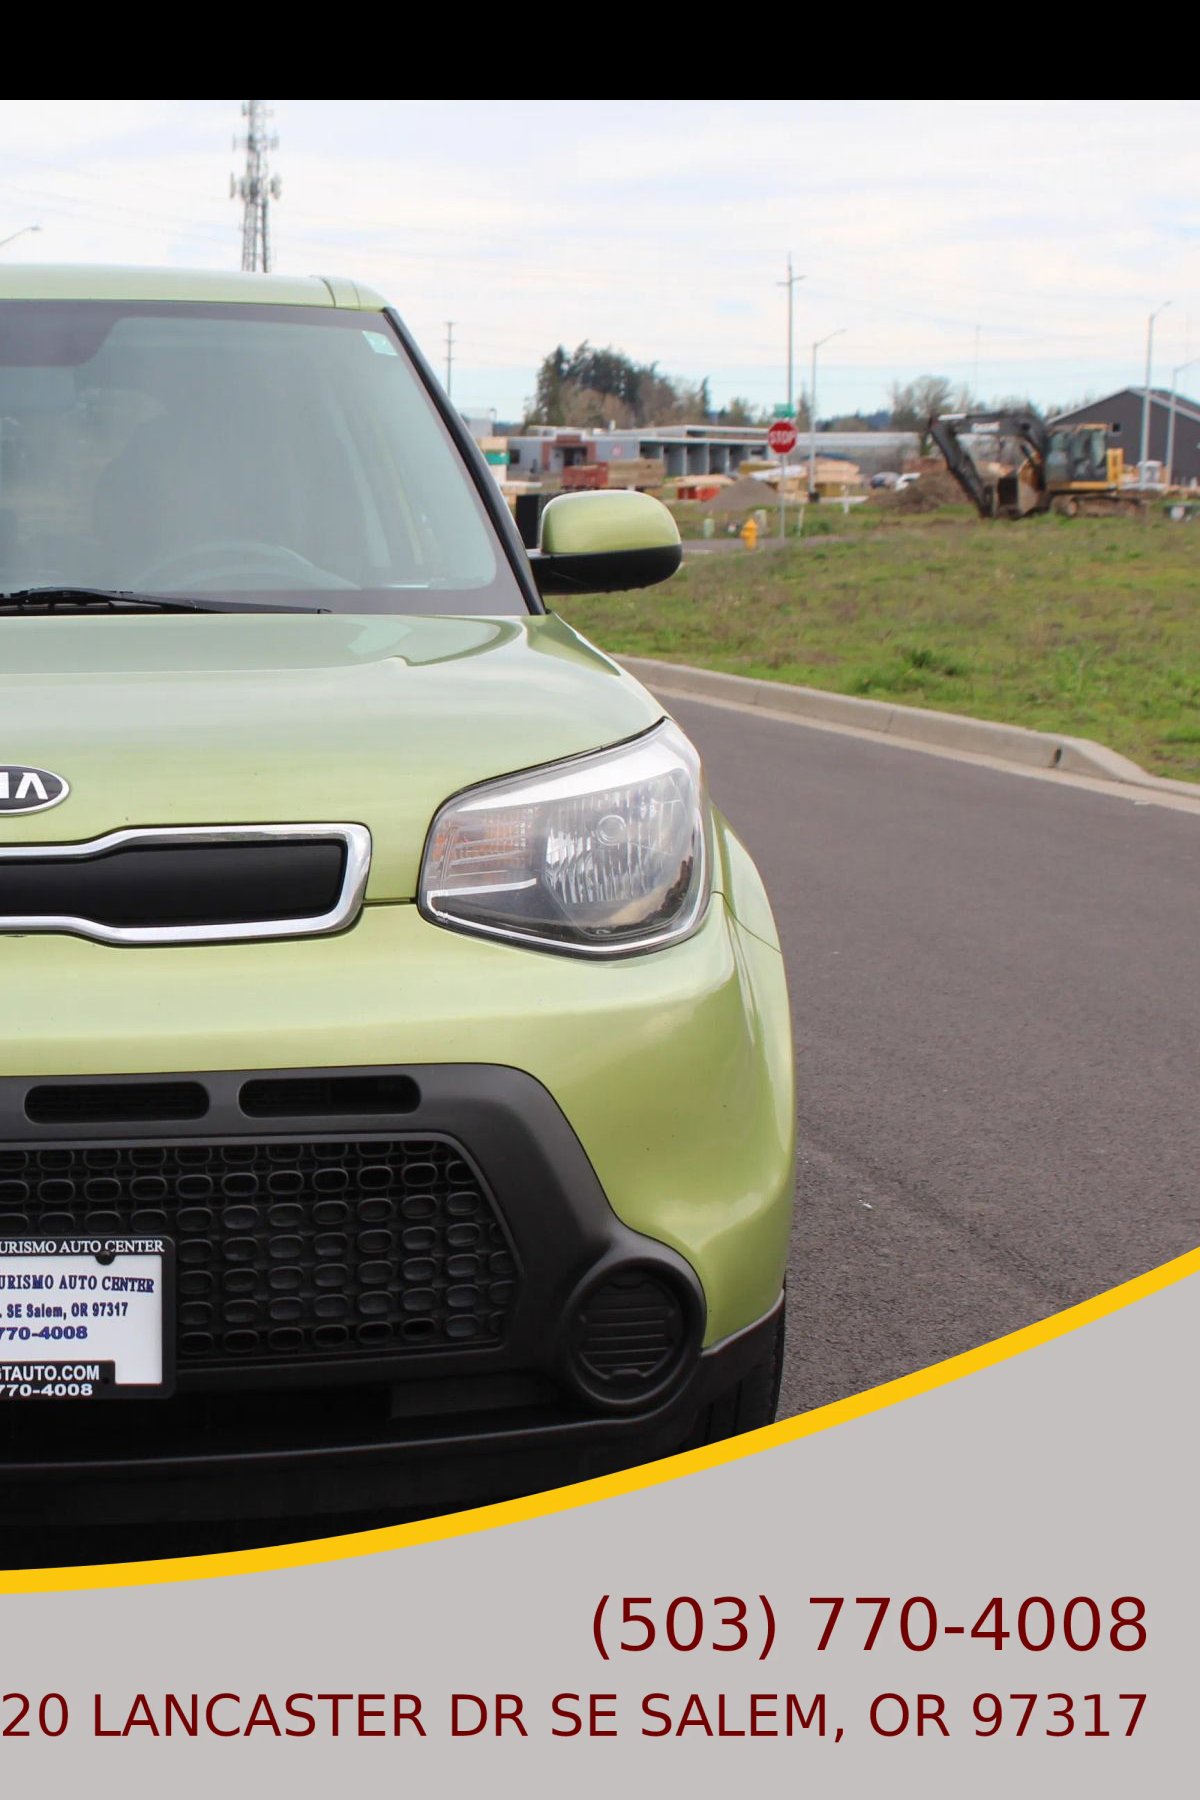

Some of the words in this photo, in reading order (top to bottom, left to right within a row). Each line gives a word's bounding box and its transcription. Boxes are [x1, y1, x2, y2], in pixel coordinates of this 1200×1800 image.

[769, 430, 796, 445] STOP
[60, 1240, 101, 1253] AUTO
[104, 1240, 165, 1253] CENTER
[58, 1275, 98, 1290] AUTO
[101, 1276, 155, 1293] CENTER
[6, 1303, 23, 1318] SE
[26, 1303, 67, 1320] Salem,
[70, 1302, 89, 1317] OR
[92, 1301, 129, 1317] 97317
